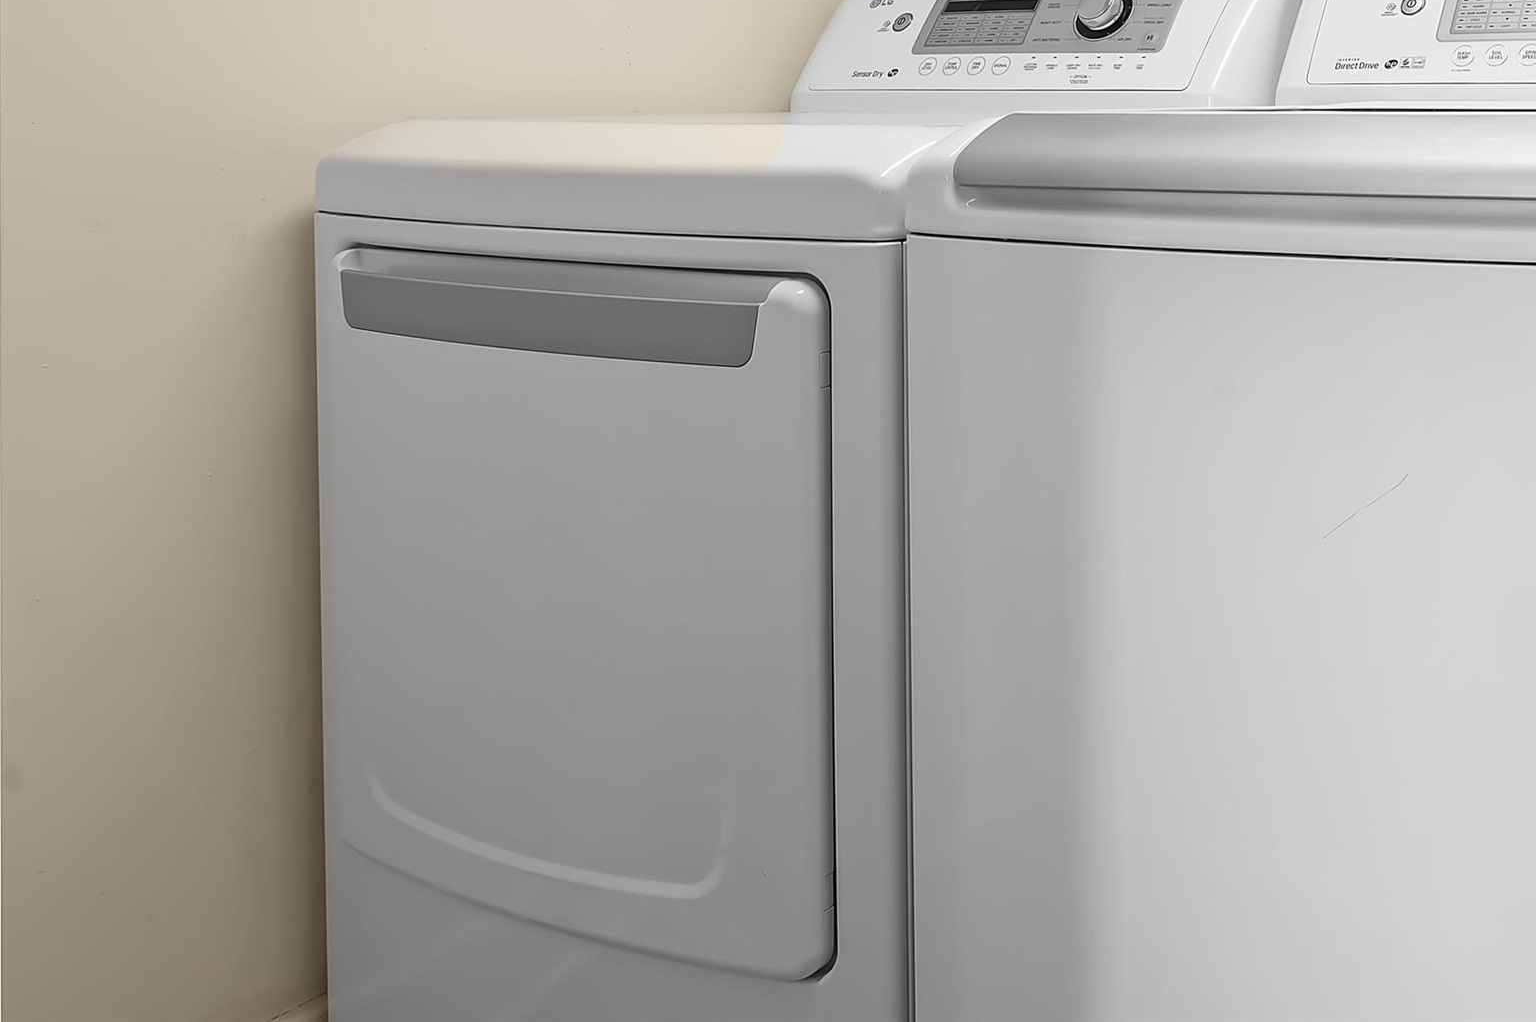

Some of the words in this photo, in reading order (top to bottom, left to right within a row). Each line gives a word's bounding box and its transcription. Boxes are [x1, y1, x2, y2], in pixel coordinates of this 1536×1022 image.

[1334, 61, 1358, 70] Direct
[1359, 61, 1380, 70] Drive
[851, 70, 872, 78] Sensor
[872, 70, 885, 79] Dry
